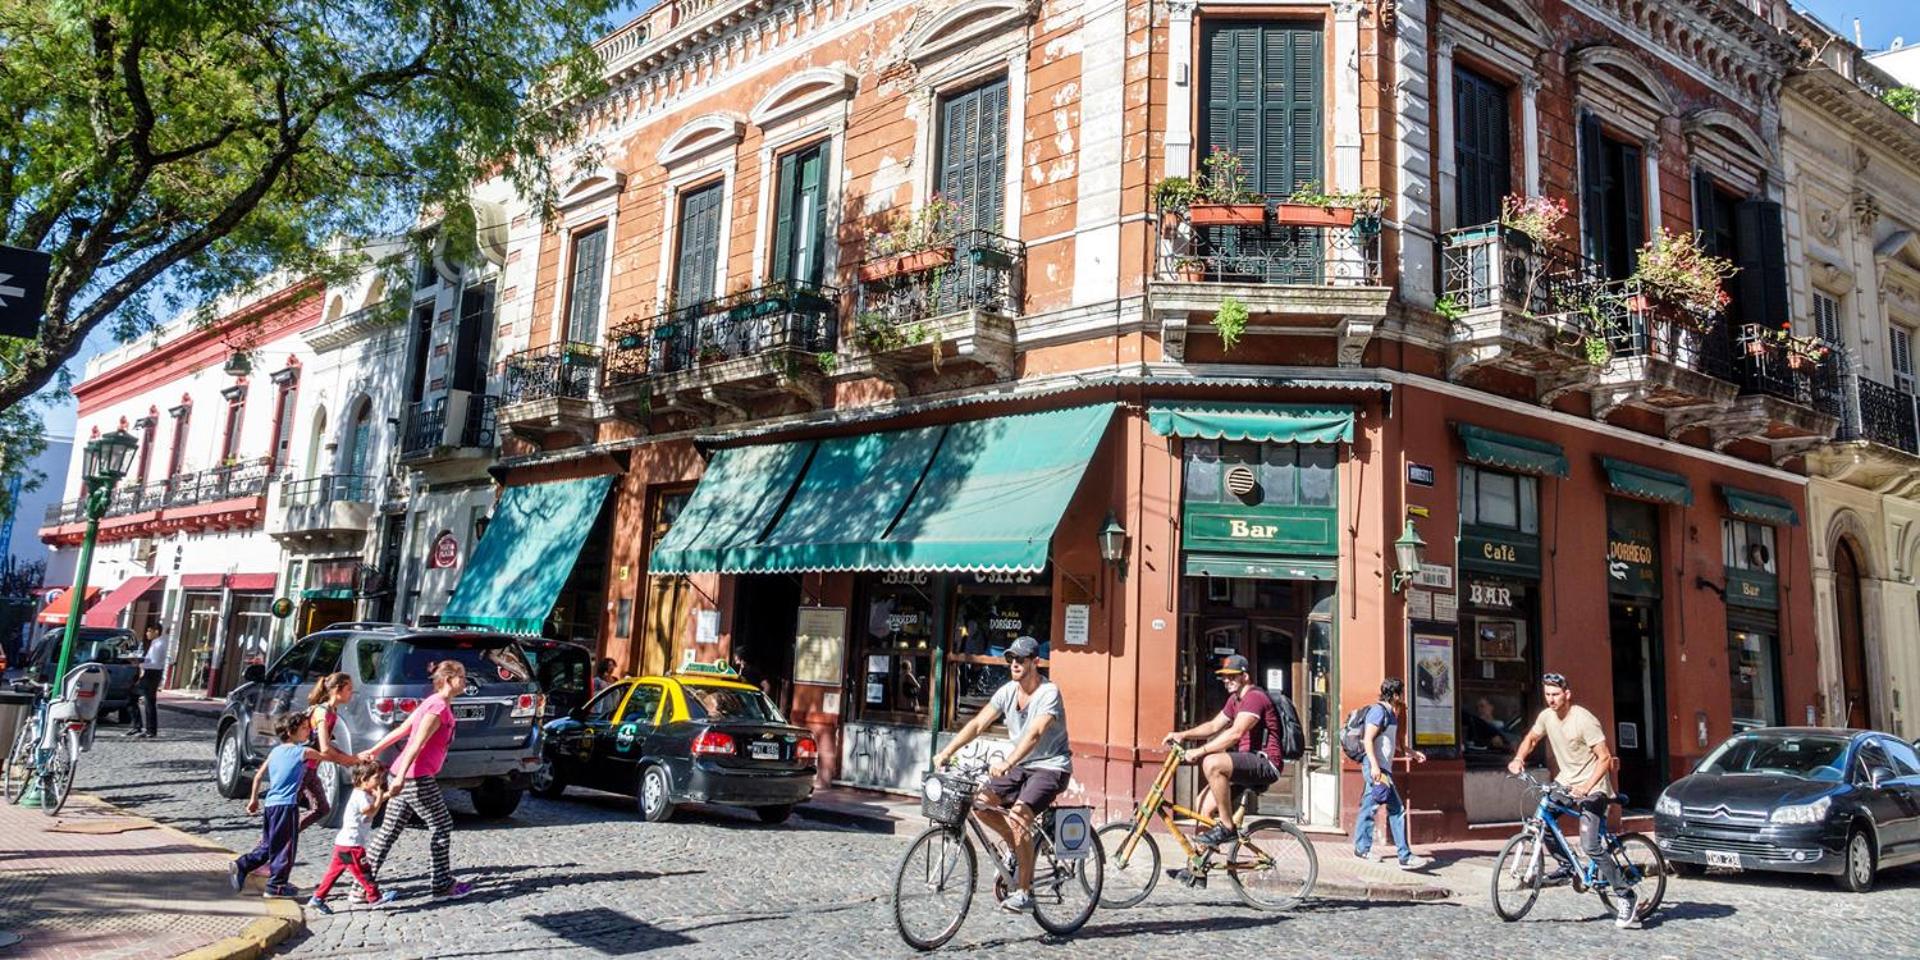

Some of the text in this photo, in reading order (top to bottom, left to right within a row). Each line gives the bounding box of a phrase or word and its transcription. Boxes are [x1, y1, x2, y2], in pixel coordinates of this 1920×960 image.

[1230, 520, 1278, 538] Bar
[1484, 543, 1516, 562] Café
[1469, 584, 1512, 607] BAR
[1742, 582, 1760, 596] Bar
